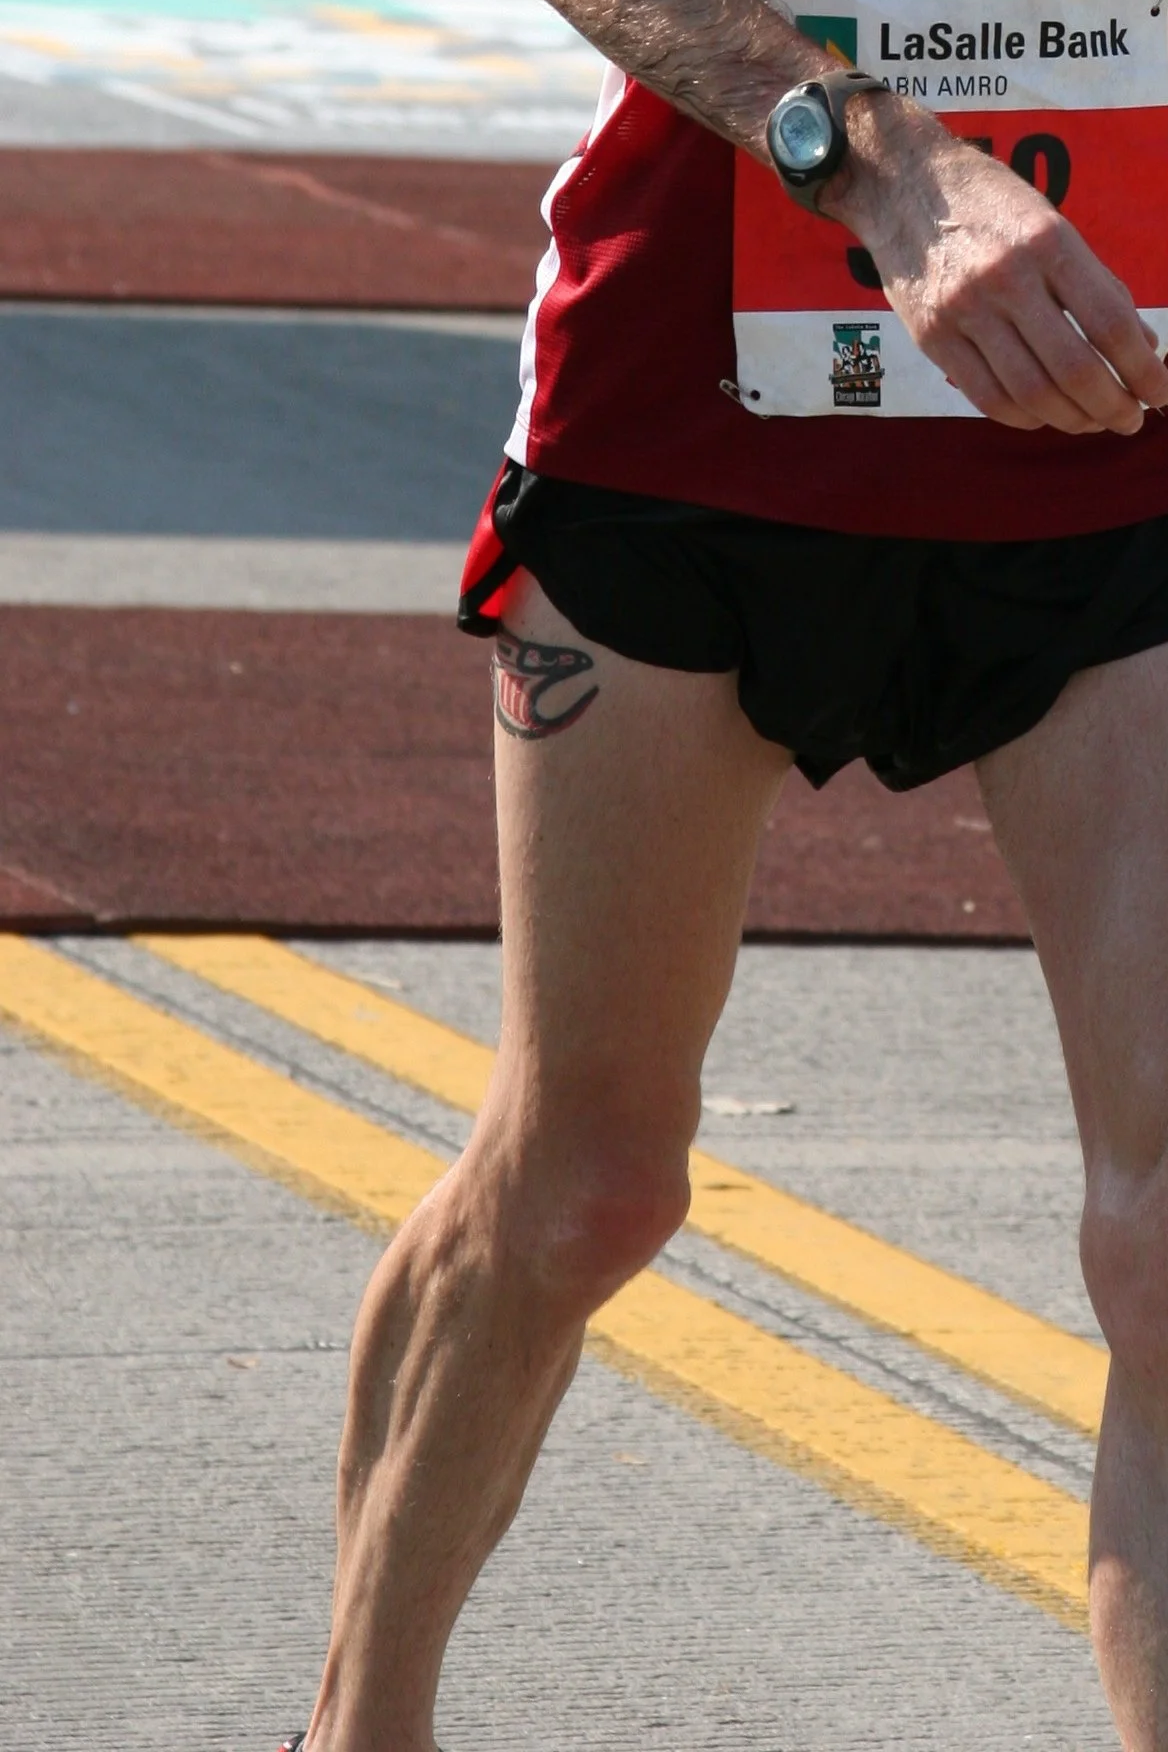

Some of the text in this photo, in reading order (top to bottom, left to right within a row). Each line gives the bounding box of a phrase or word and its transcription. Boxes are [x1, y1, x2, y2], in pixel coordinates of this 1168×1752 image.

[880, 17, 1131, 61] LaSalle Bank
[936, 74, 1009, 98] AMRO
